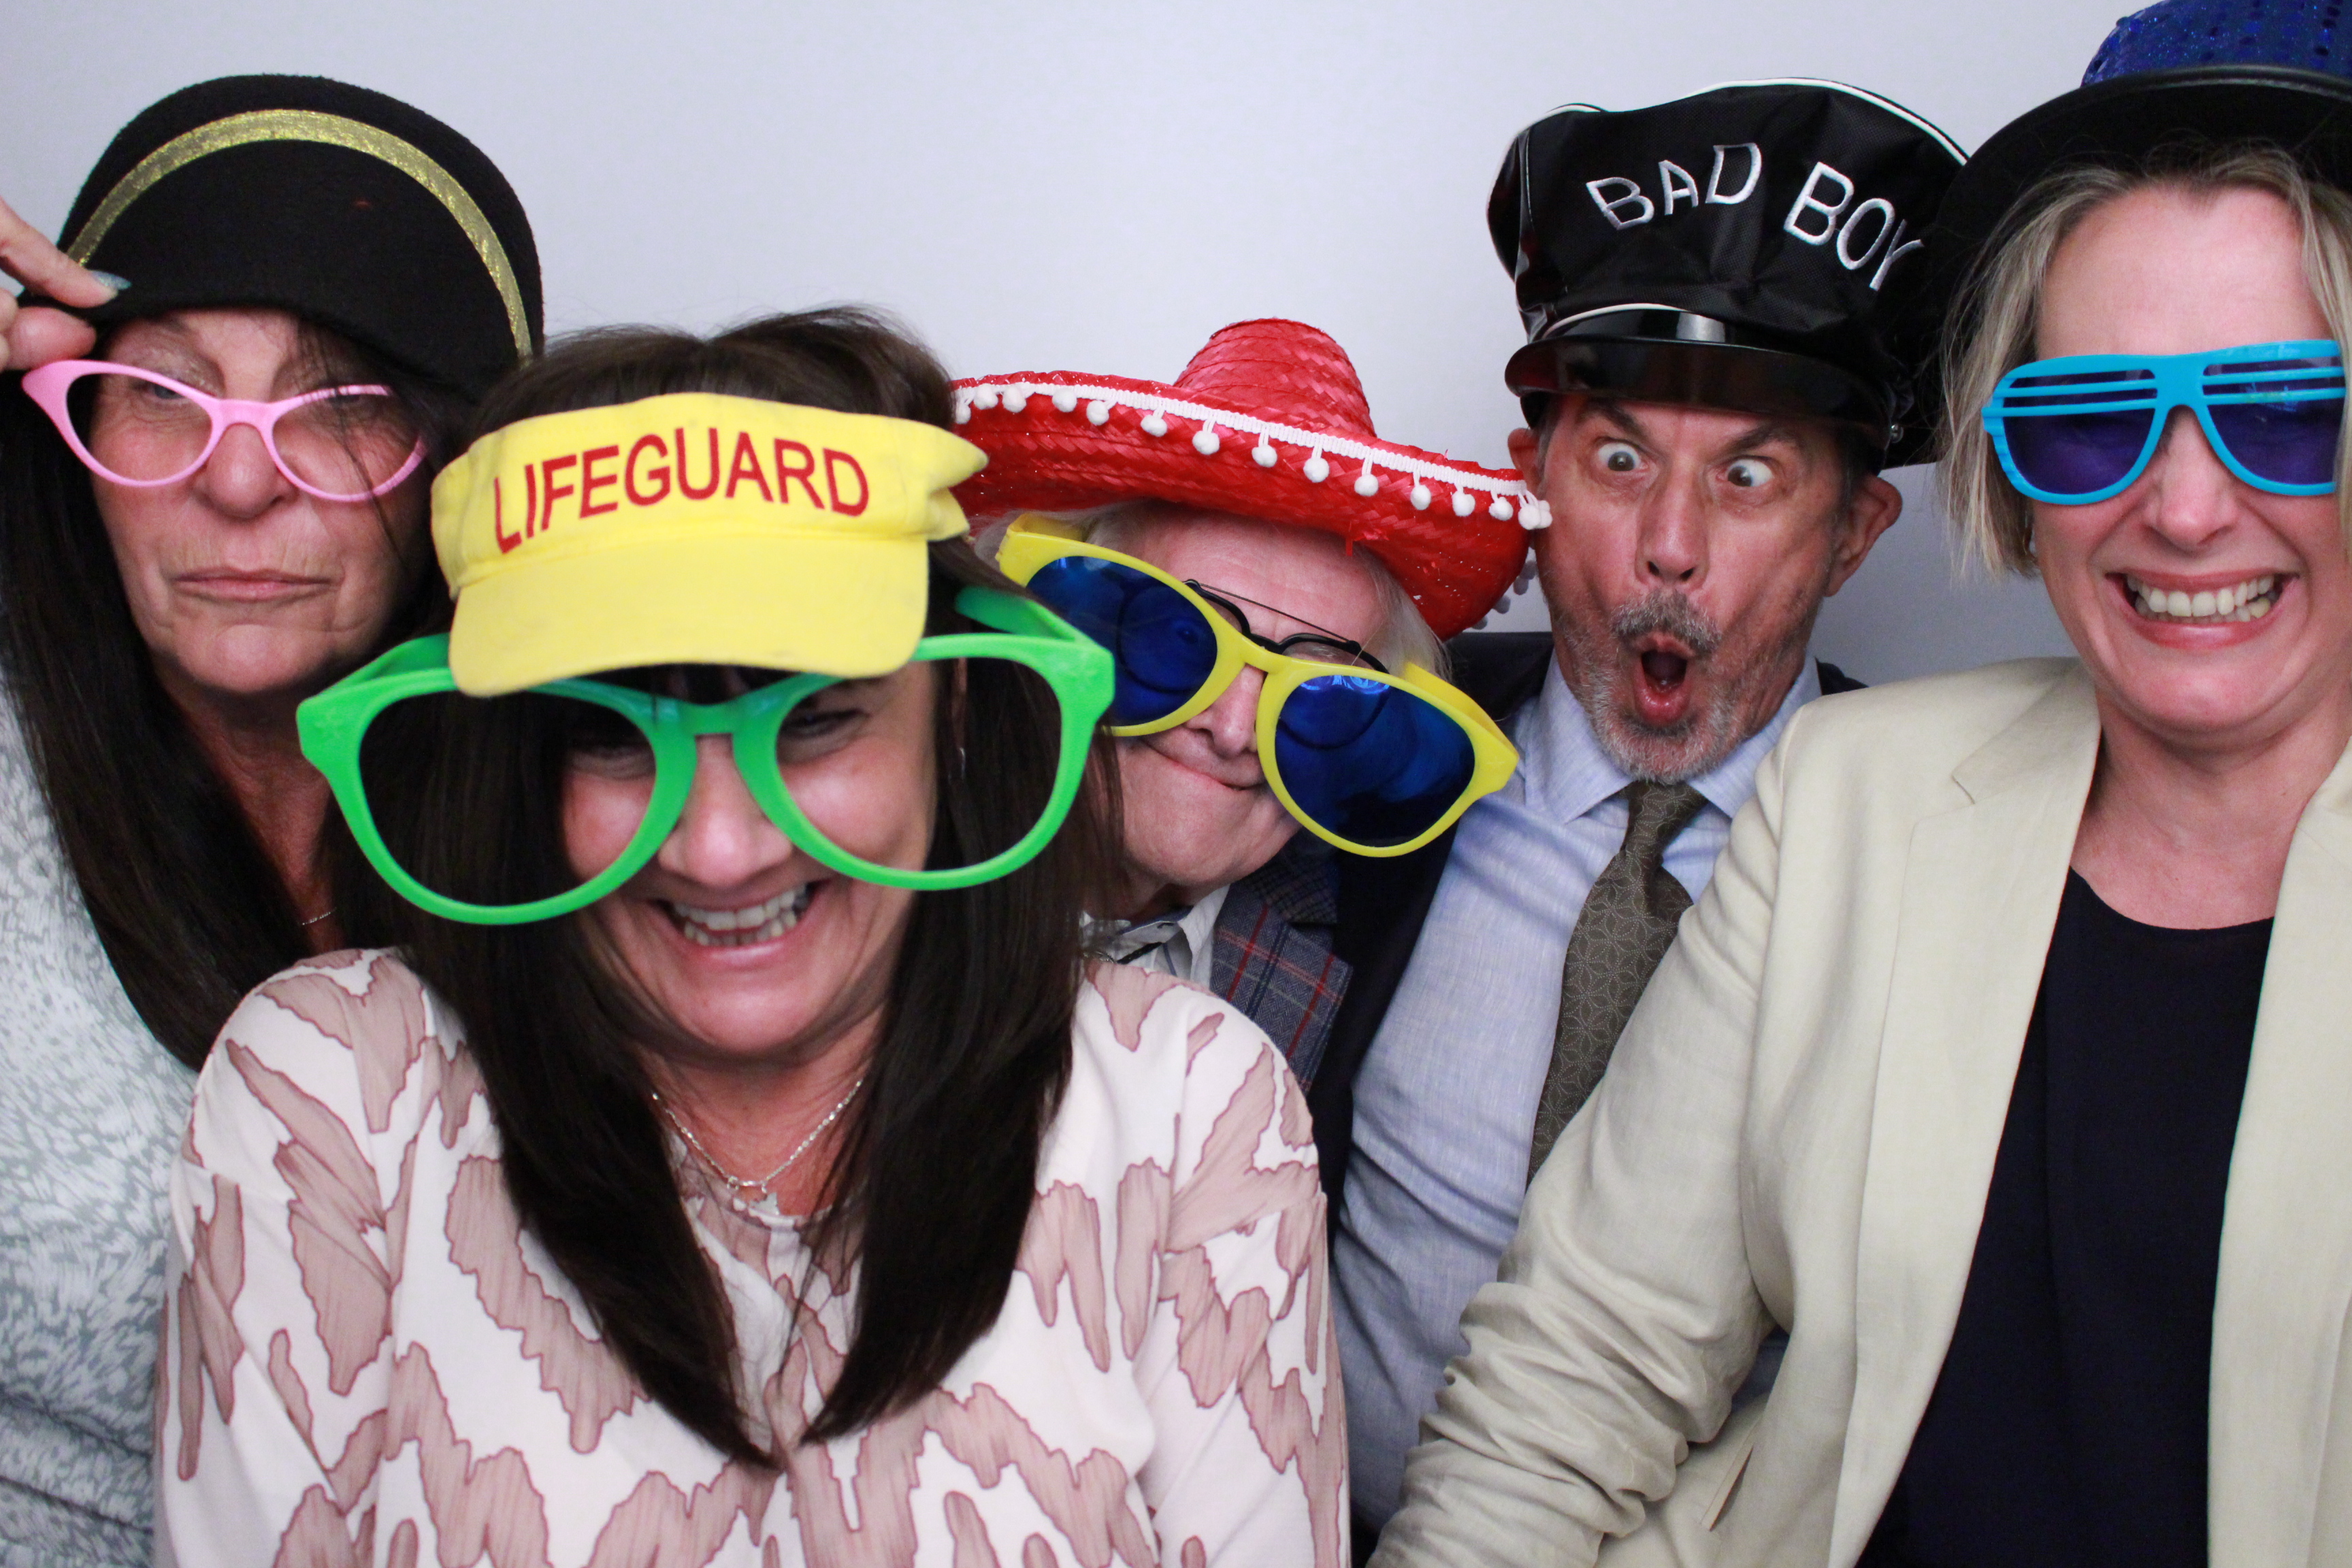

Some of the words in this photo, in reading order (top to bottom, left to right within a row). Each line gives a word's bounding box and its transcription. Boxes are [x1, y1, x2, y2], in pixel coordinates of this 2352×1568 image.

[1586, 142, 1763, 231] BAD
[1783, 161, 1925, 292] BOY
[493, 426, 870, 555] LIFEGUARD
